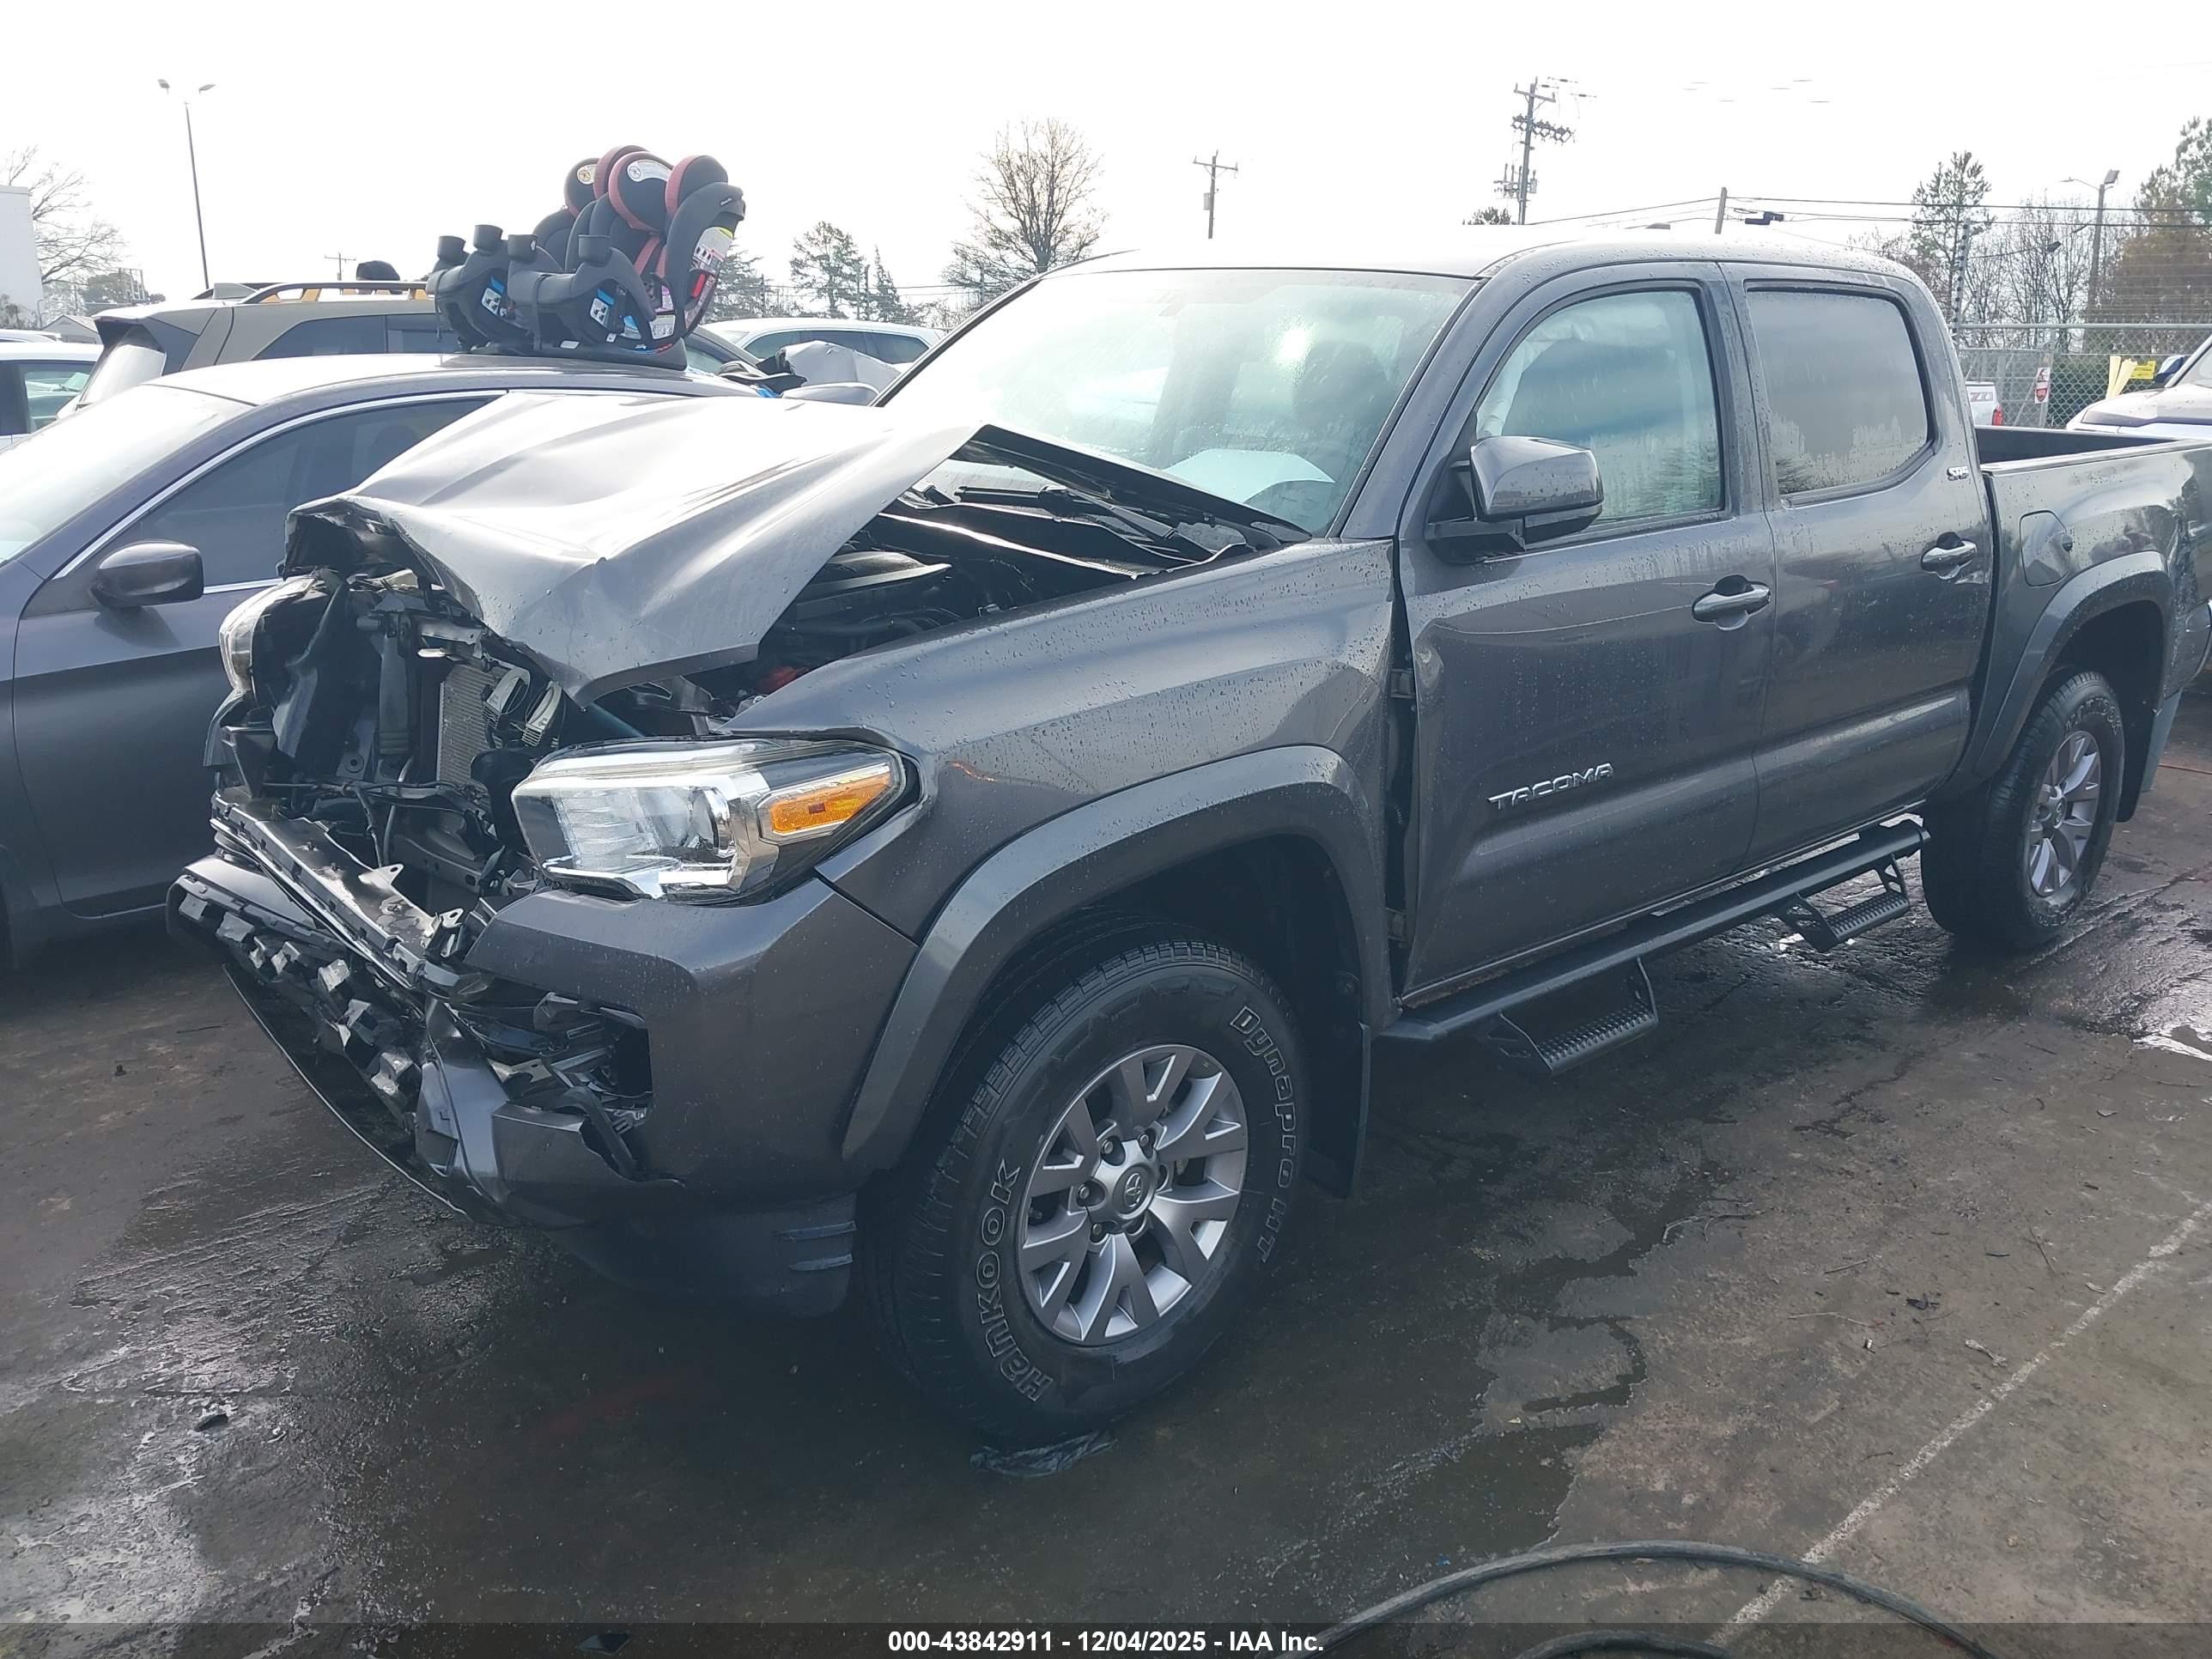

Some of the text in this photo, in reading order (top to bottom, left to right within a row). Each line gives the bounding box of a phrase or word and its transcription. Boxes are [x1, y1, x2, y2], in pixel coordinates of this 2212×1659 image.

[1487, 763, 1614, 811] TACOMA
[1230, 1005, 1297, 1263] Dynapro HT
